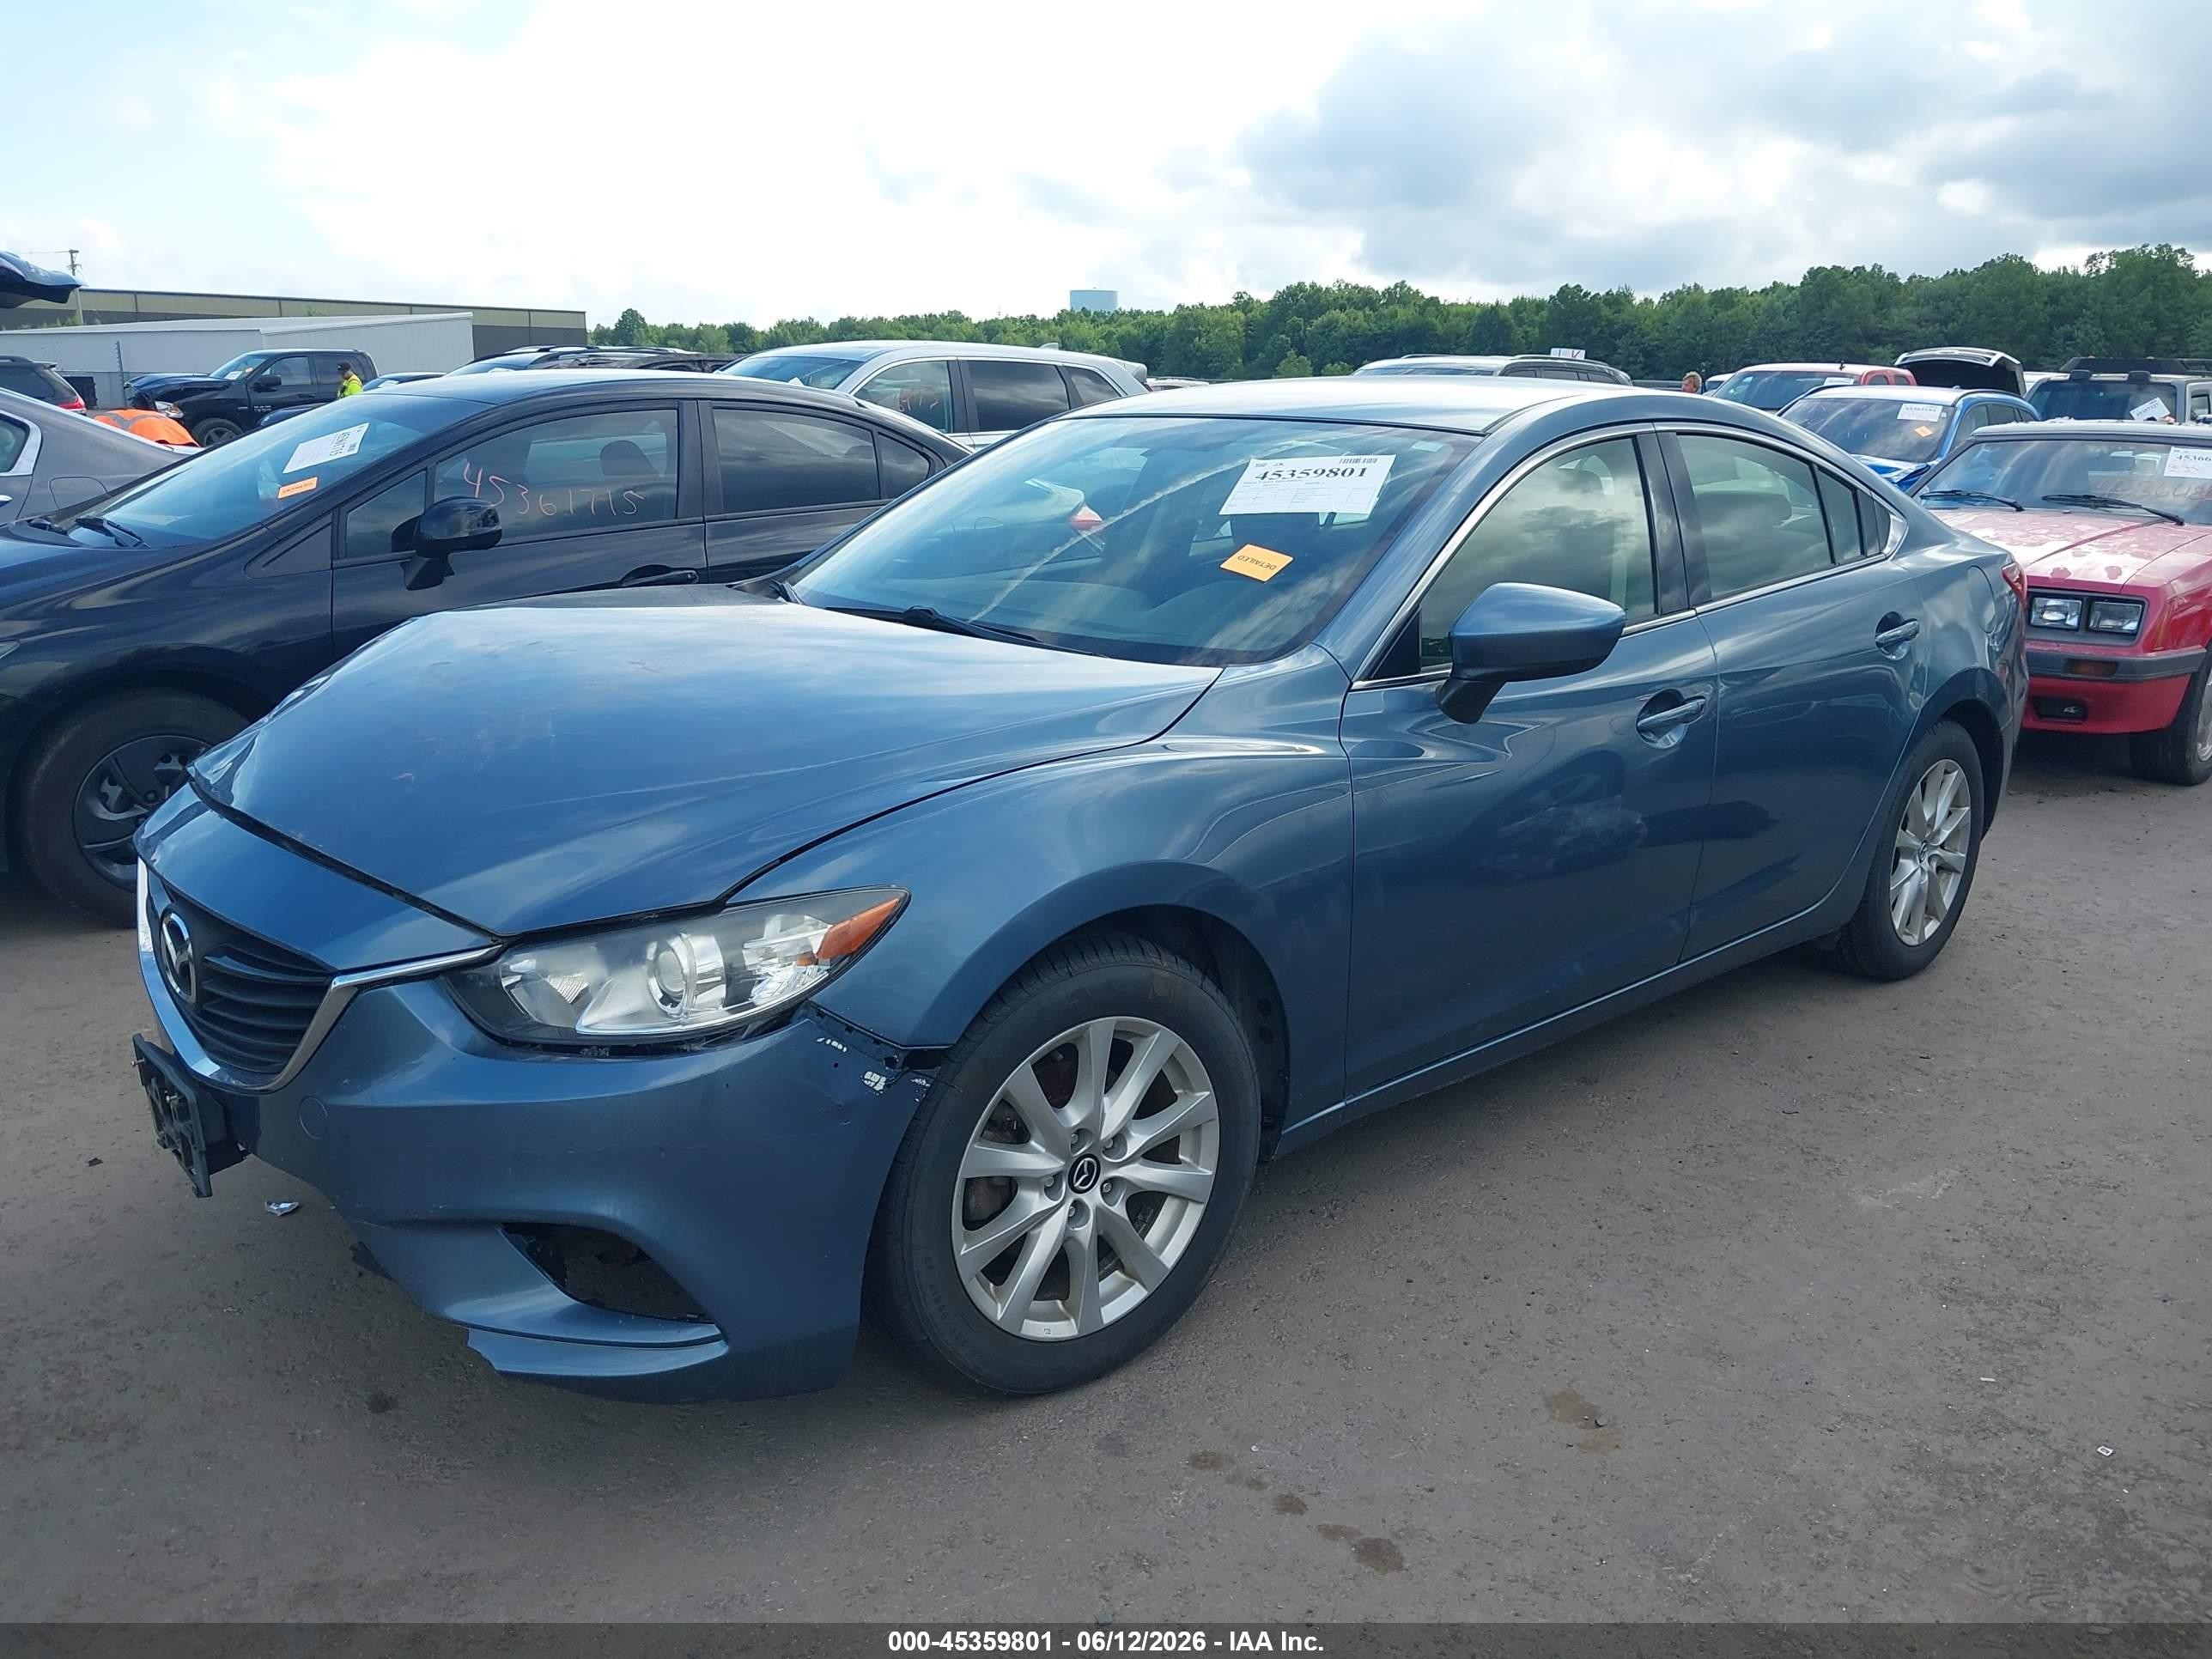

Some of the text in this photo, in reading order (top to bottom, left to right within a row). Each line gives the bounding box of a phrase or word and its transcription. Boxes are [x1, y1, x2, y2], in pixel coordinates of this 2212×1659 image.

[1255, 467, 1368, 481] 45359801
[463, 460, 645, 516] 45361715
[1237, 555, 1278, 571] DETAILED
